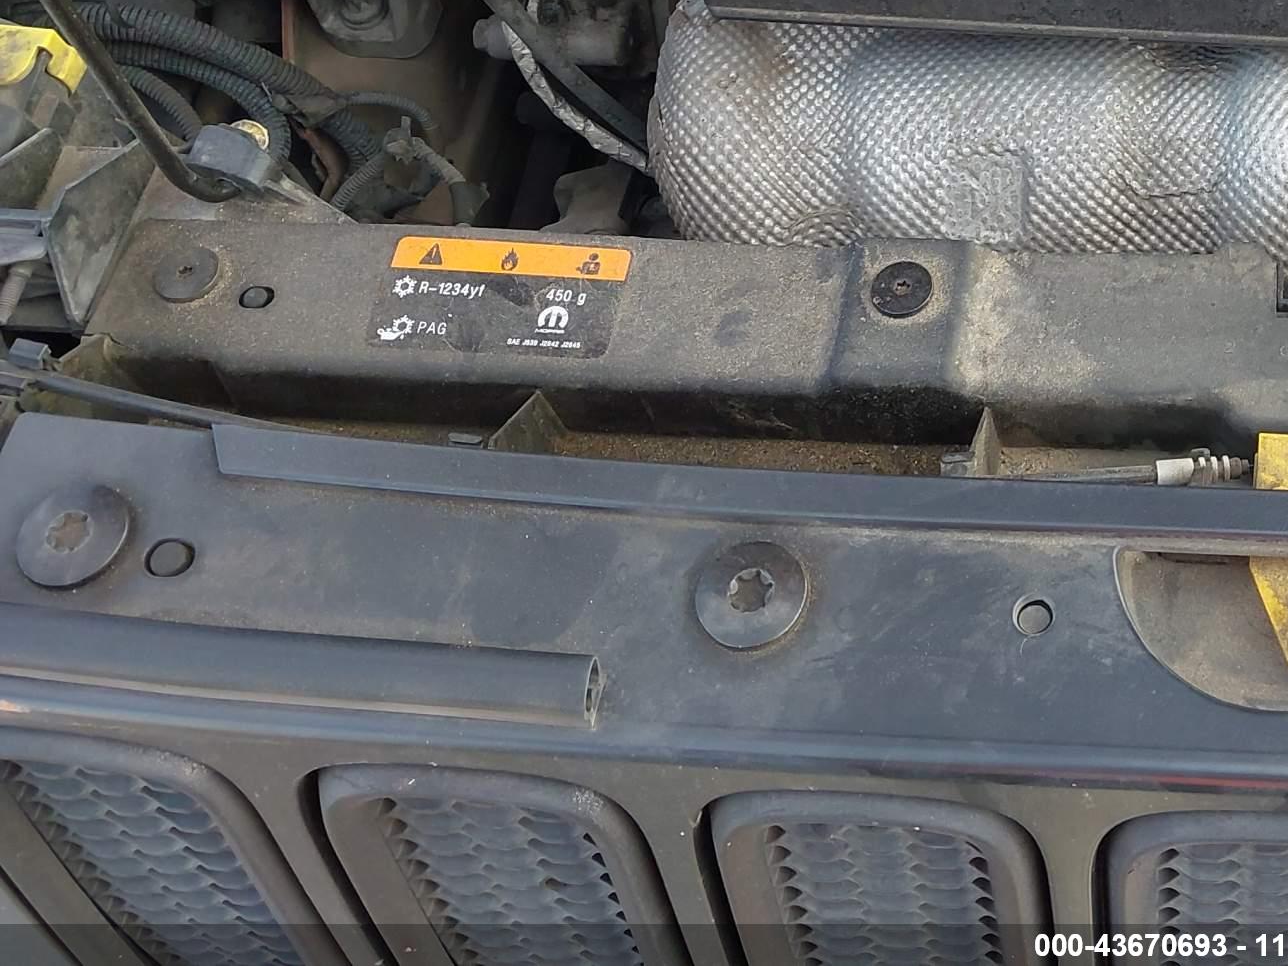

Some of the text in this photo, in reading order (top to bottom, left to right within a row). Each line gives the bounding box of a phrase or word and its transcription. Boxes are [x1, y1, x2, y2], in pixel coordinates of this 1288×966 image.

[418, 281, 486, 300] R-1234yf
[545, 288, 587, 306] 450 g
[416, 321, 447, 335] PAG
